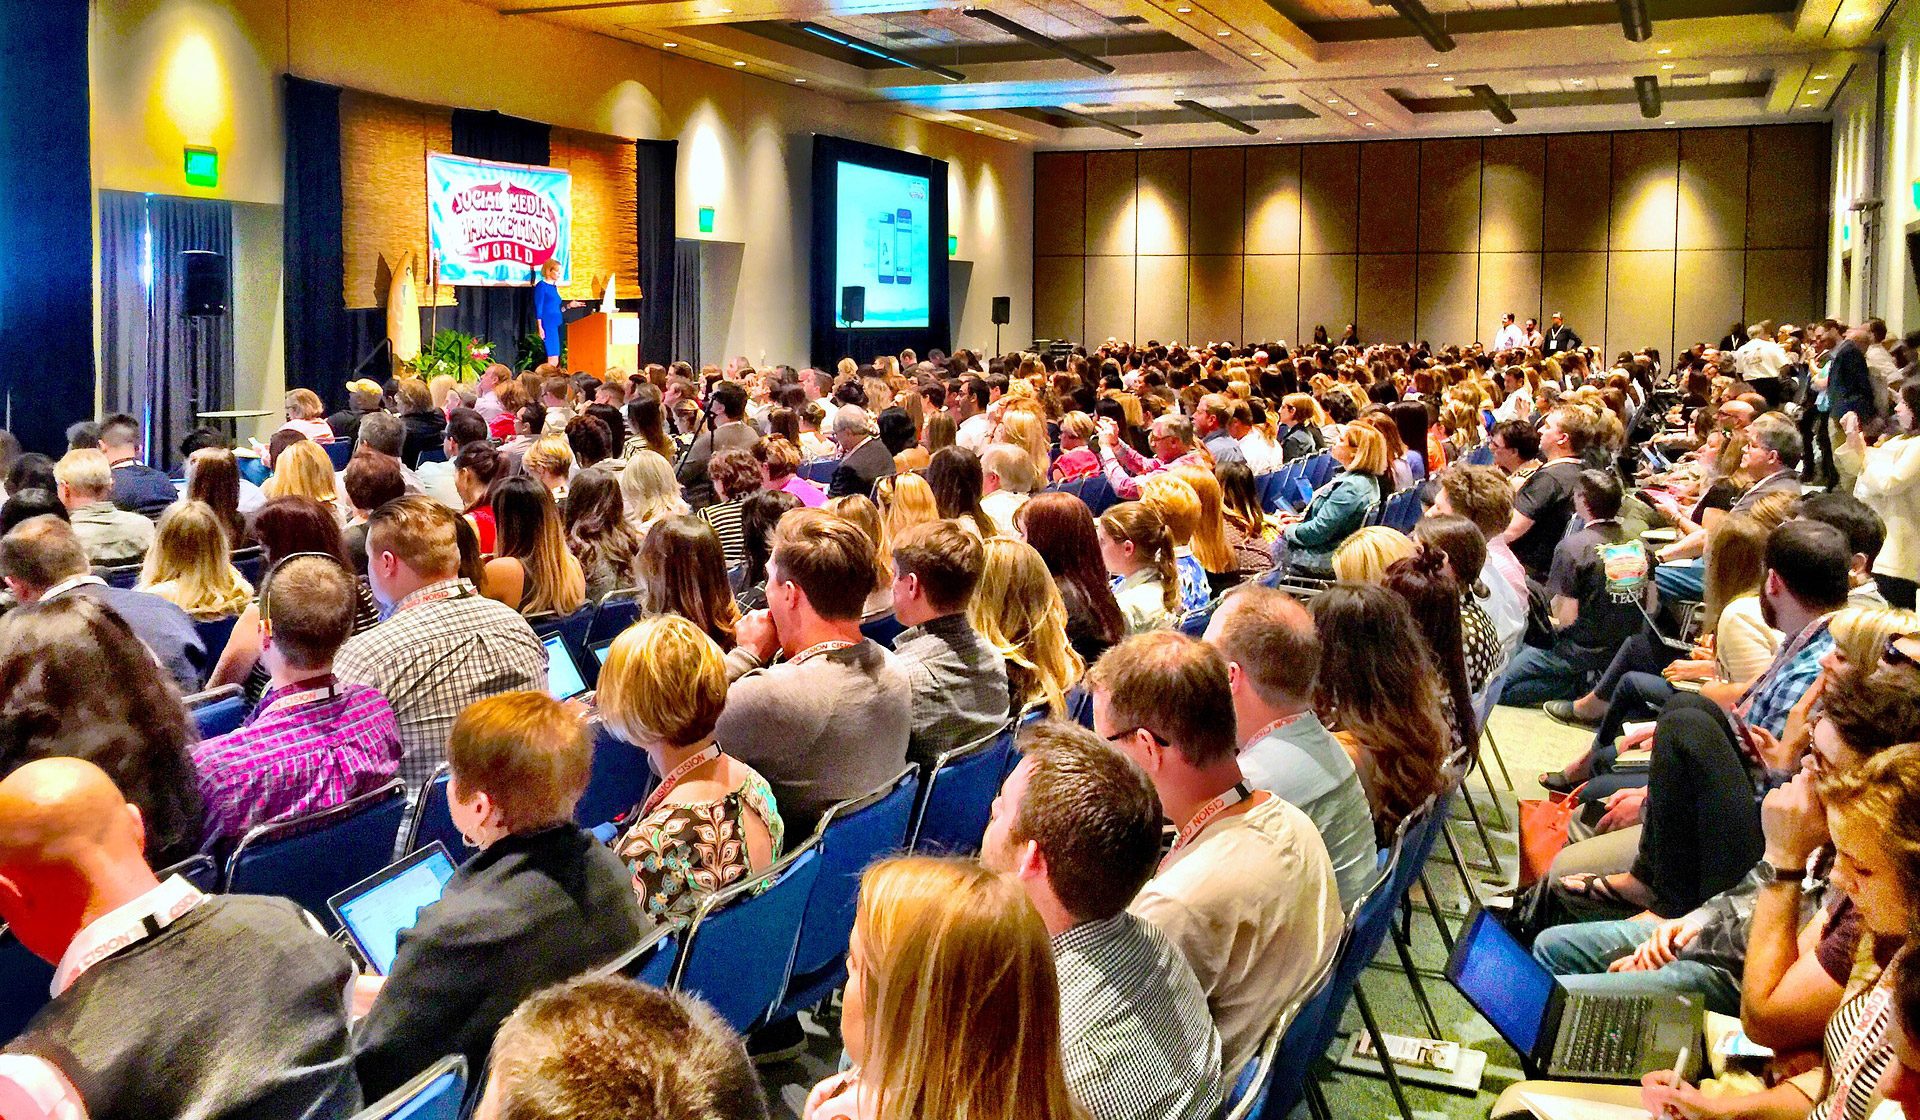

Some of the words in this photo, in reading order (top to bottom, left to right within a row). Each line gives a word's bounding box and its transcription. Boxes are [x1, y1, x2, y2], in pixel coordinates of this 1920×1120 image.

[456, 189, 503, 214] SOCIAL
[508, 192, 552, 222] MEDIA
[460, 214, 553, 250] MARKETING
[477, 243, 534, 264] WORLD
[423, 590, 449, 602] CISION
[1609, 587, 1644, 604] TECH
[803, 643, 828, 658] CISION
[284, 692, 317, 705] CISION
[651, 774, 676, 802] CISION
[676, 753, 706, 776] CISION
[1192, 798, 1225, 828] CISION
[81, 932, 132, 967] CISION
[169, 891, 199, 919] CISION
[1857, 991, 1885, 1033] CISION
